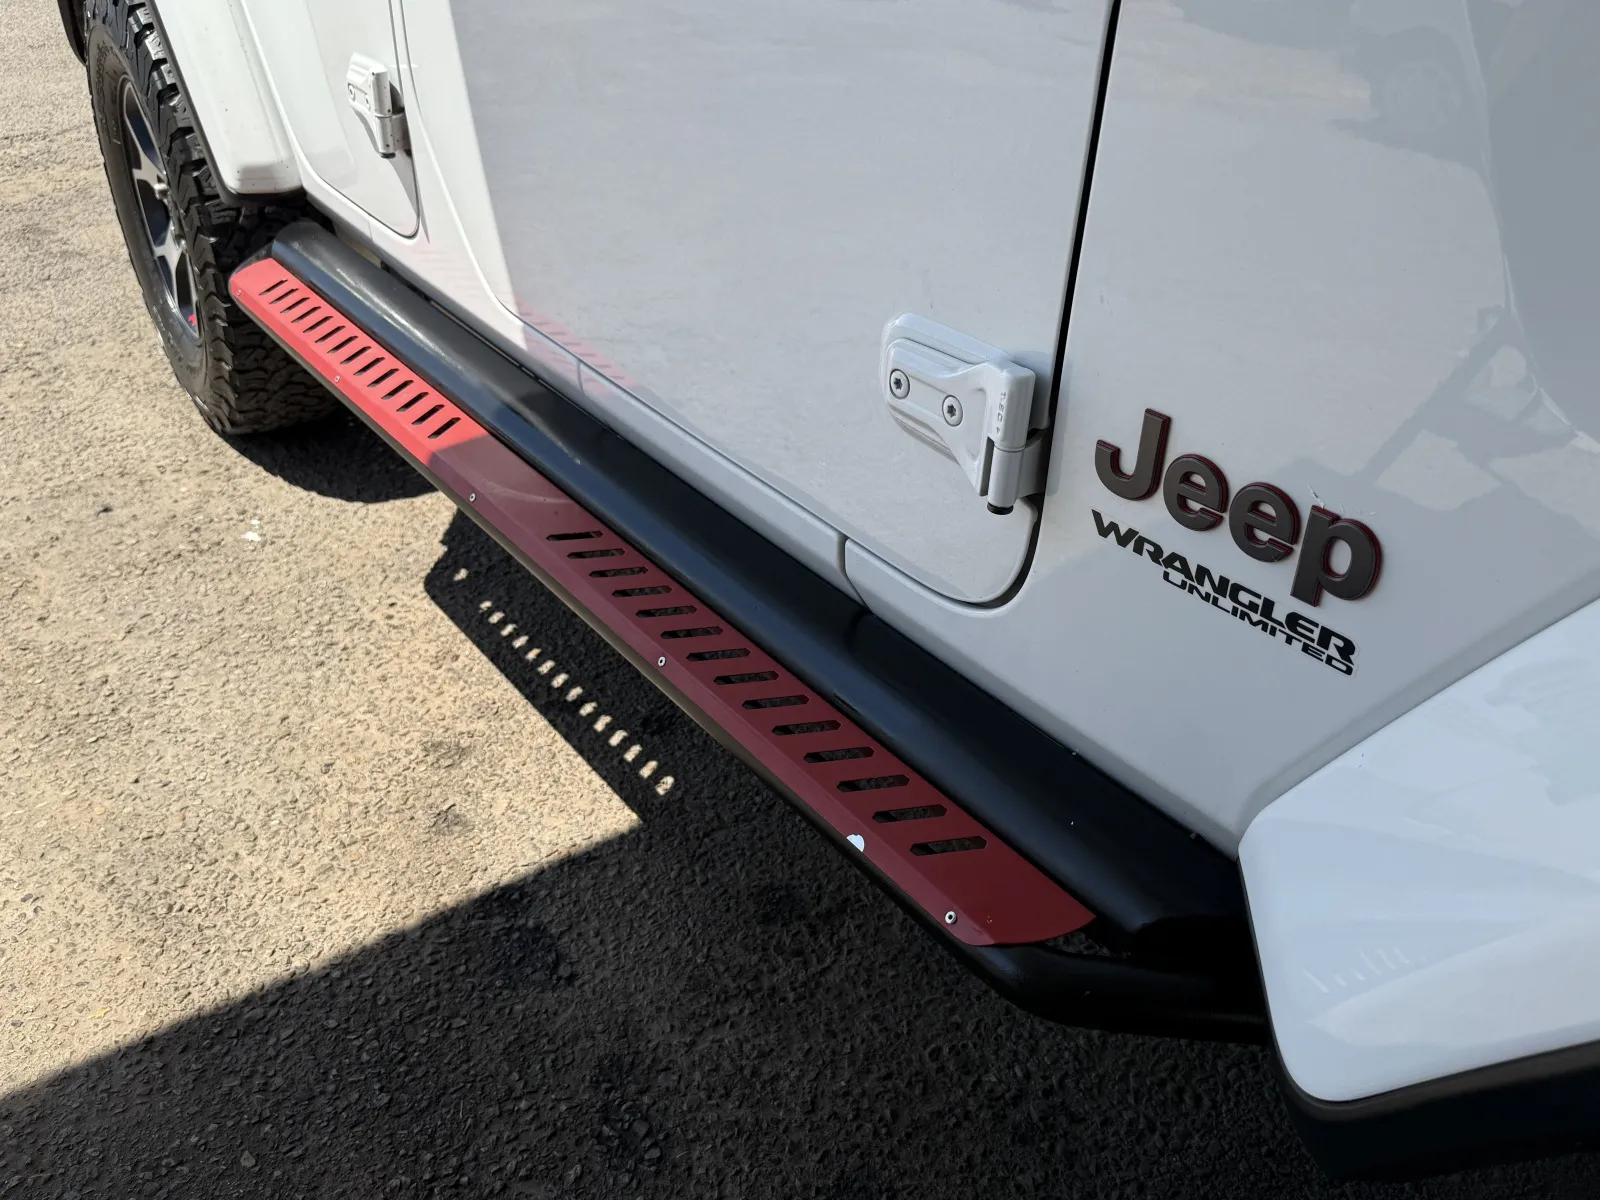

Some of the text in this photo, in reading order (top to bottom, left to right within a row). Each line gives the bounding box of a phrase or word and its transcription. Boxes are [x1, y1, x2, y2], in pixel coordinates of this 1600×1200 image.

[1094, 408, 1383, 607] Jeep
[1091, 508, 1356, 665] WRANGLER
[1162, 570, 1354, 676] UNLIMITED
